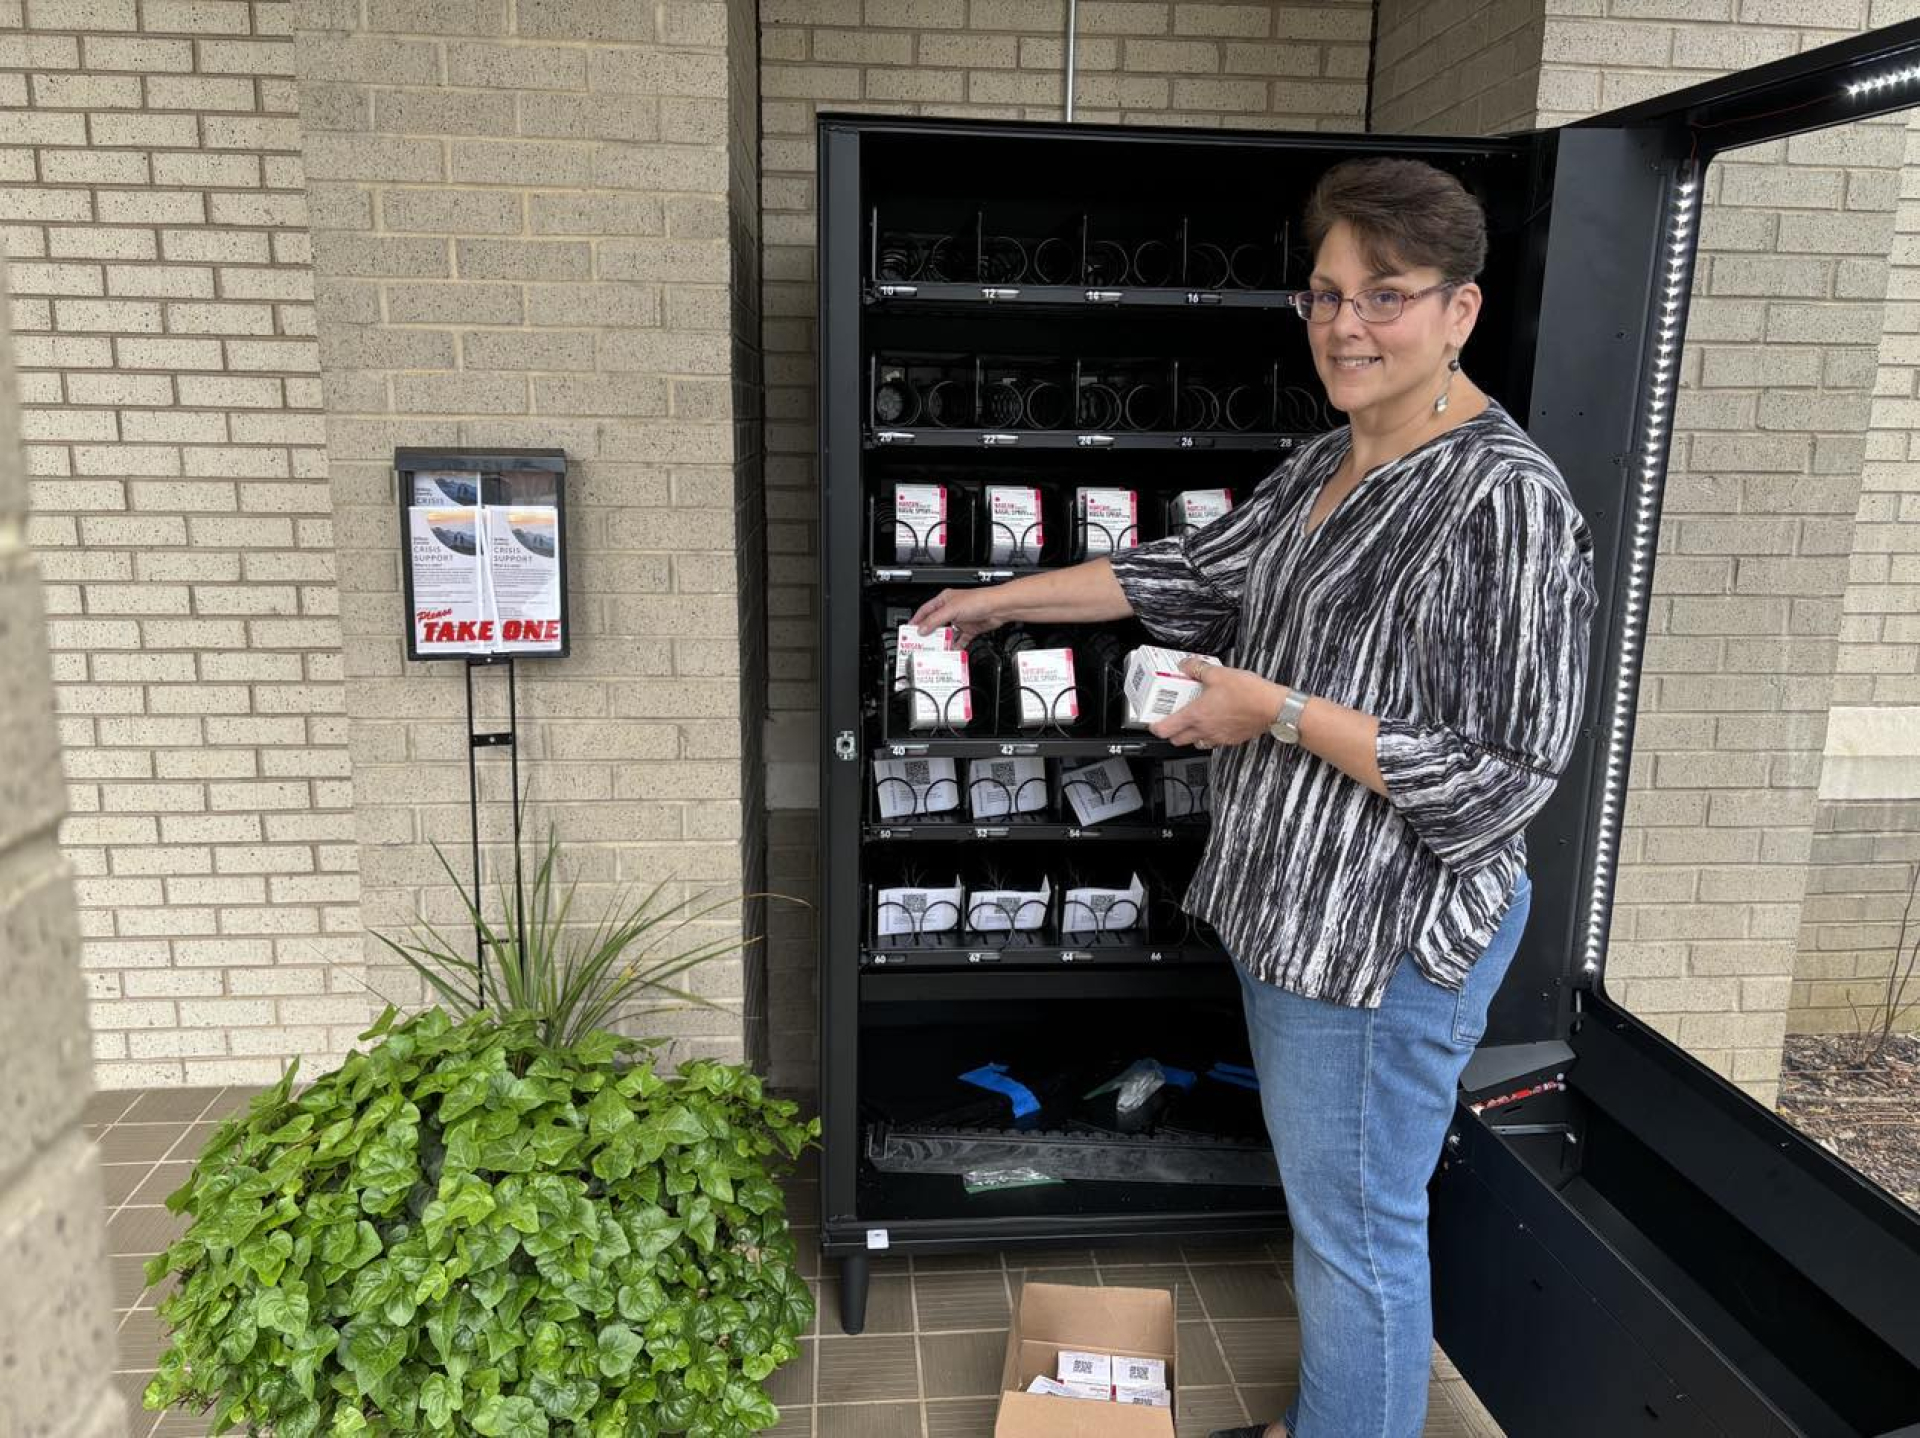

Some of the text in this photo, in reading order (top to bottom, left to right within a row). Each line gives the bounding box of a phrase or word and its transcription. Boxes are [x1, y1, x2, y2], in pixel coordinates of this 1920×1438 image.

[1188, 293, 1199, 303] 16
[1181, 437, 1192, 447] 26
[1280, 438, 1292, 447] 28
[414, 554, 453, 562] SUPPORT
[493, 554, 532, 562] SUPPORT
[416, 608, 452, 623] Please
[424, 620, 560, 642] TAKE ONE
[892, 746, 905, 755] 40
[1001, 745, 1014, 755] 42
[1109, 745, 1122, 754] 44
[880, 829, 891, 838] 50
[977, 828, 988, 838] 52
[1069, 829, 1080, 838] 54
[1162, 829, 1173, 838] 56
[875, 955, 887, 963] 60
[969, 953, 980, 963] 62
[1062, 951, 1074, 961] 64
[1151, 952, 1162, 961] 66
